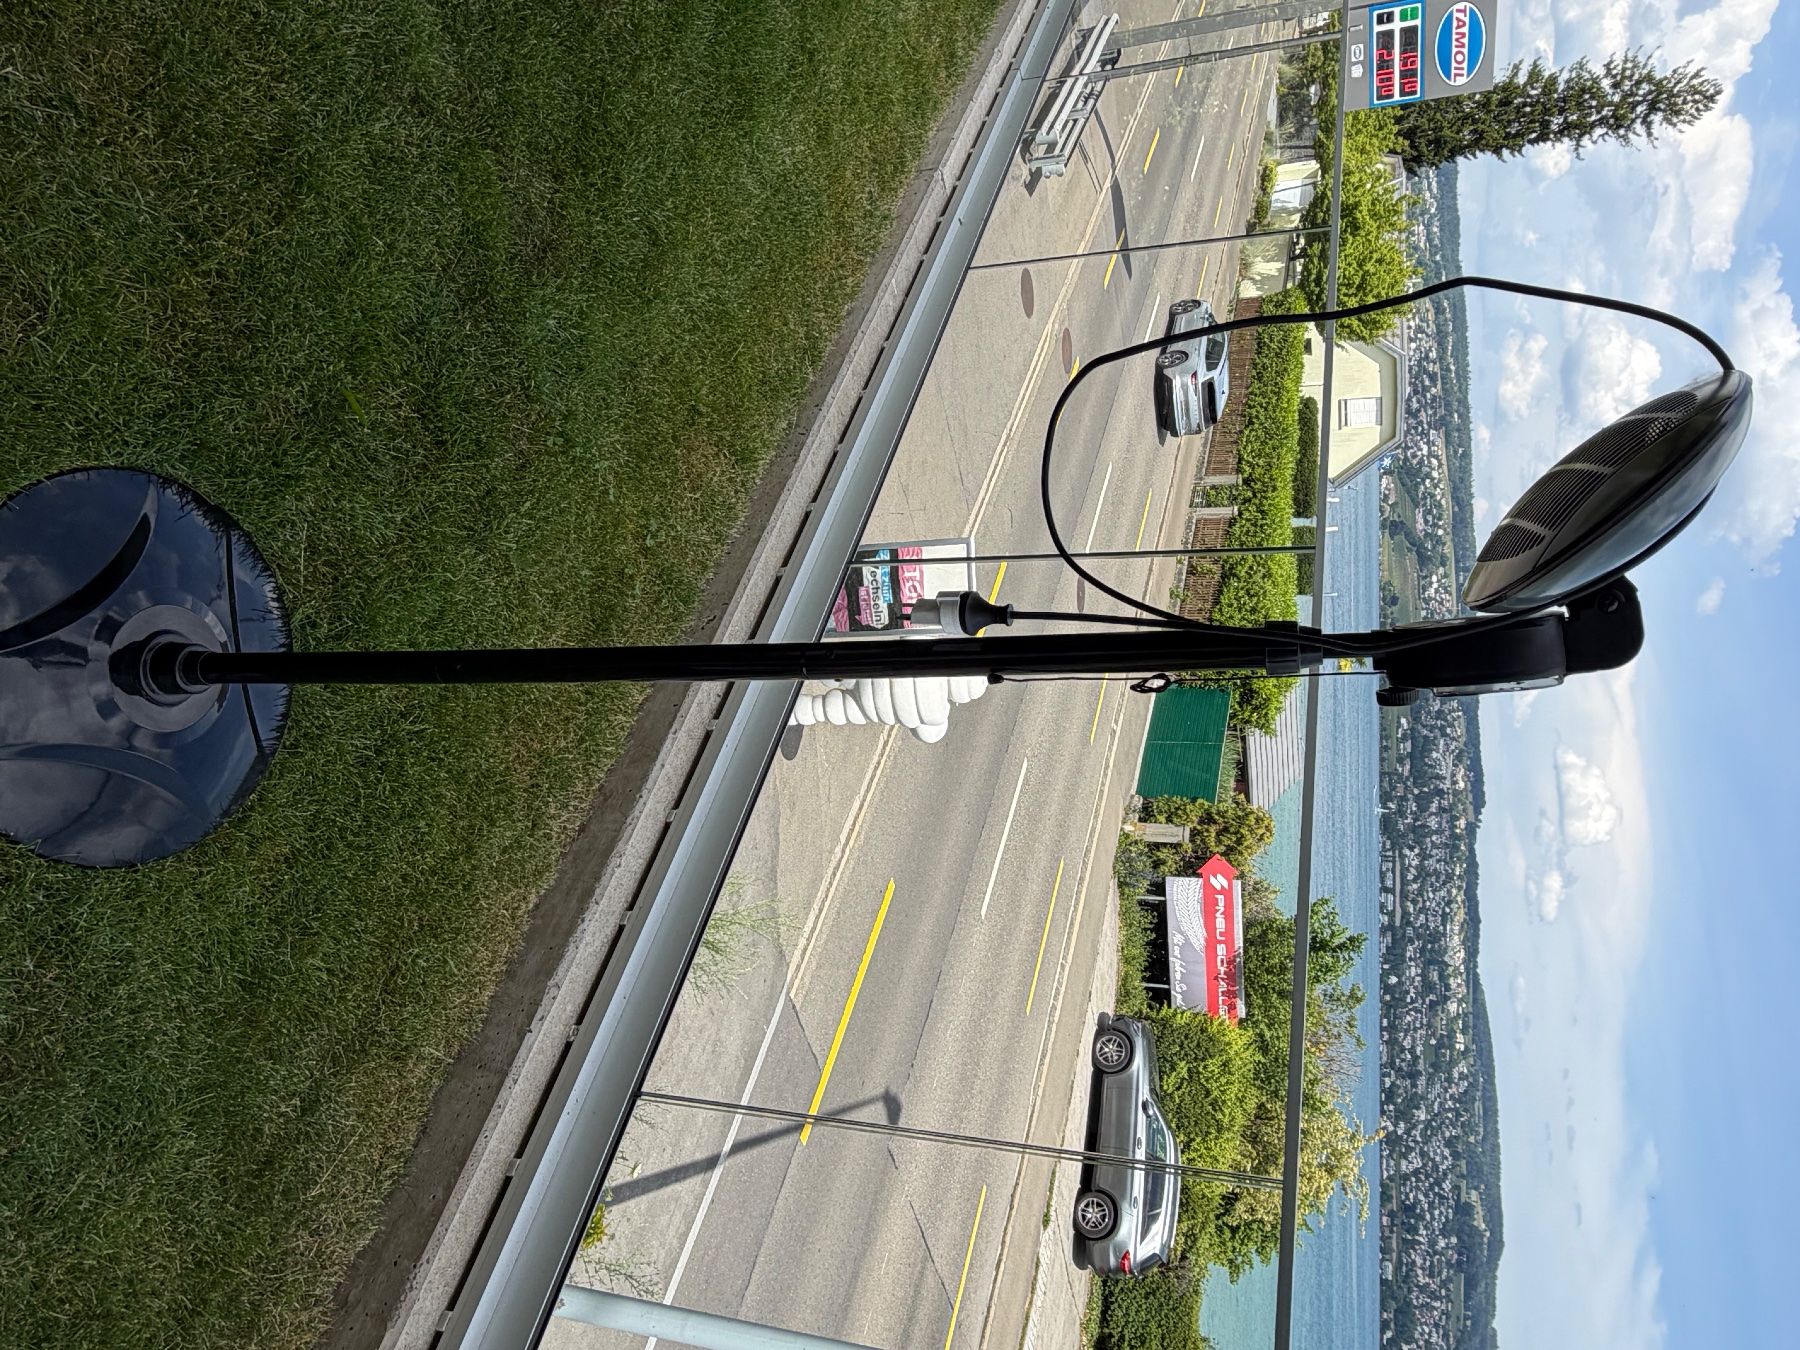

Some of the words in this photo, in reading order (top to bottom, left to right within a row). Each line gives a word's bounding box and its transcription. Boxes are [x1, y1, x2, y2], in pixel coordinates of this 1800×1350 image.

[1453, 5, 1467, 83] TAMOIL
[870, 566, 884, 625] echseln!
[1214, 894, 1226, 940] PNEU
